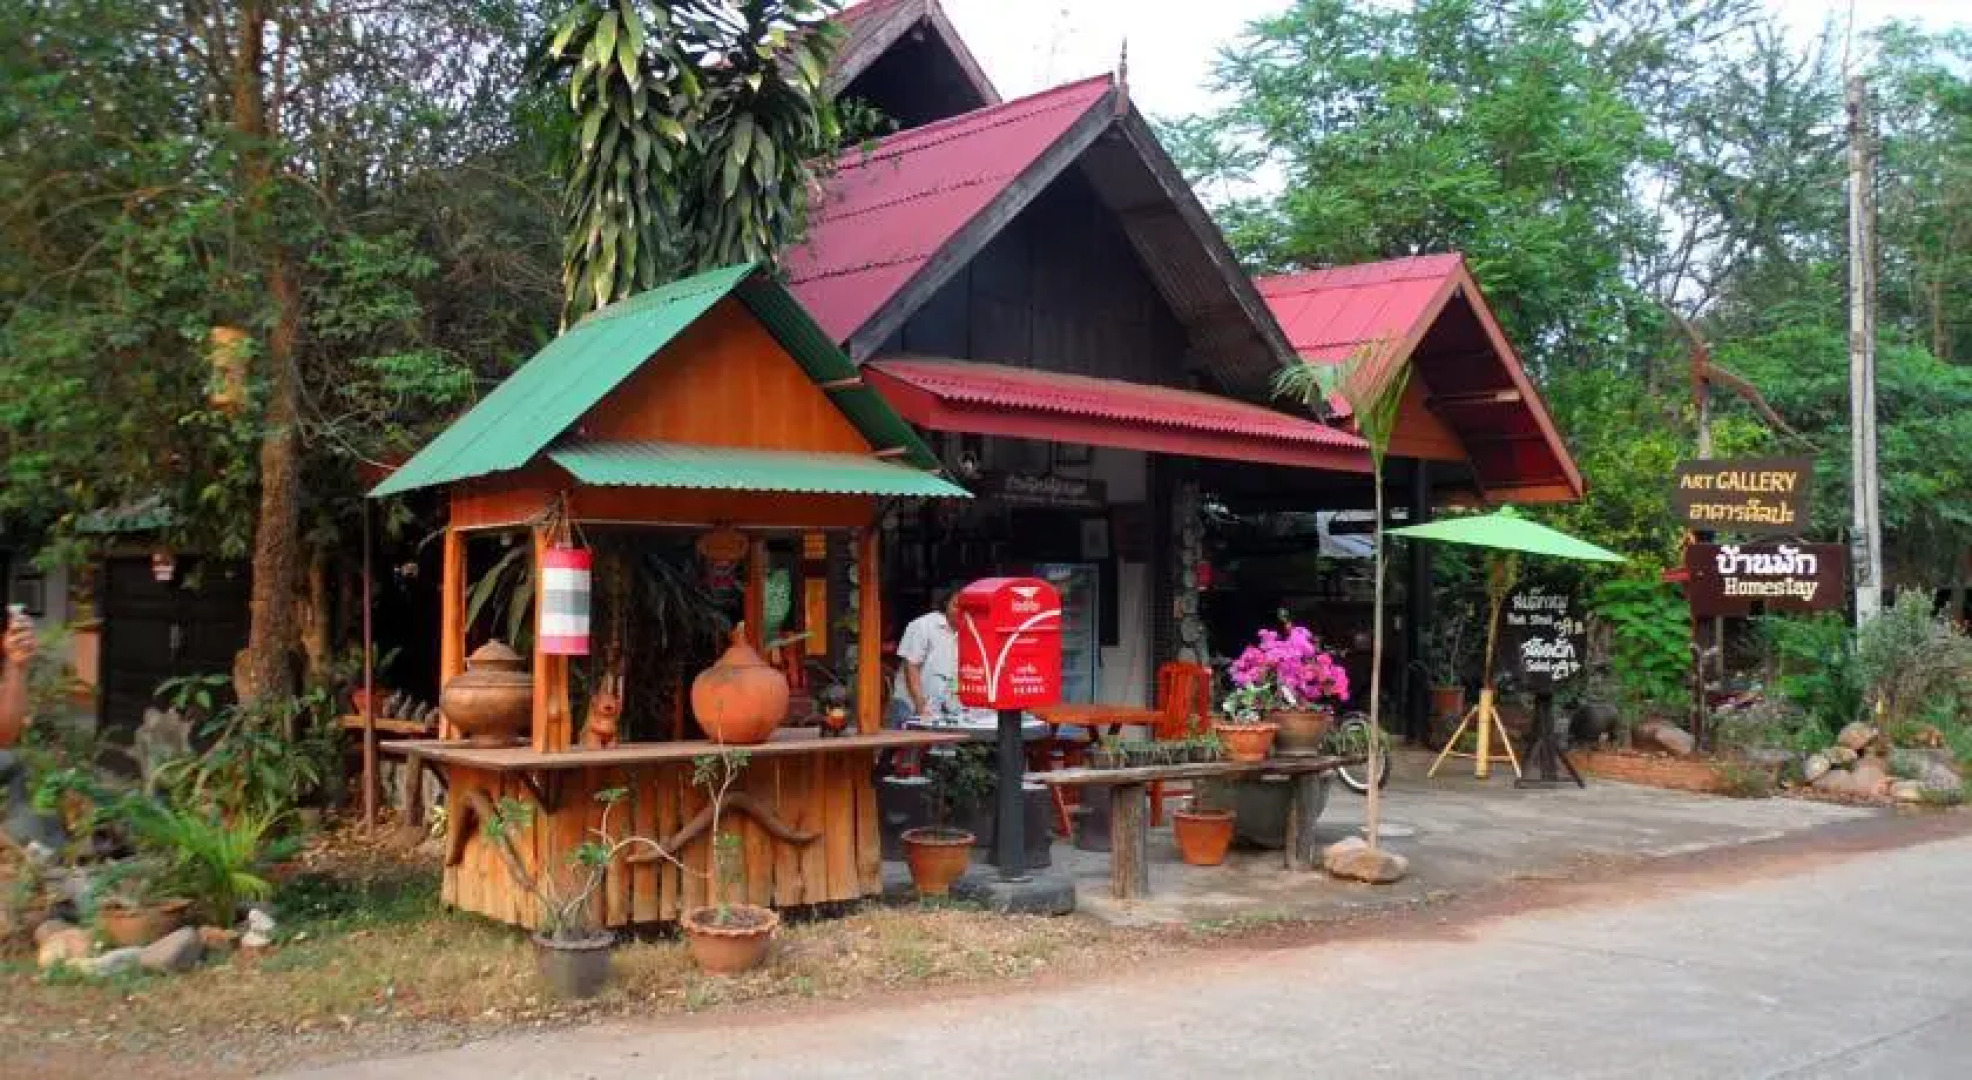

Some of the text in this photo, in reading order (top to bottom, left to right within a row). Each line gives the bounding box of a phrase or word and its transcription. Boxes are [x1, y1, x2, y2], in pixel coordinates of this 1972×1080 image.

[1681, 471, 1797, 492] ART GALLERY
[1716, 544, 1818, 575] บ้านพัก
[1722, 577, 1819, 602] Homestay
